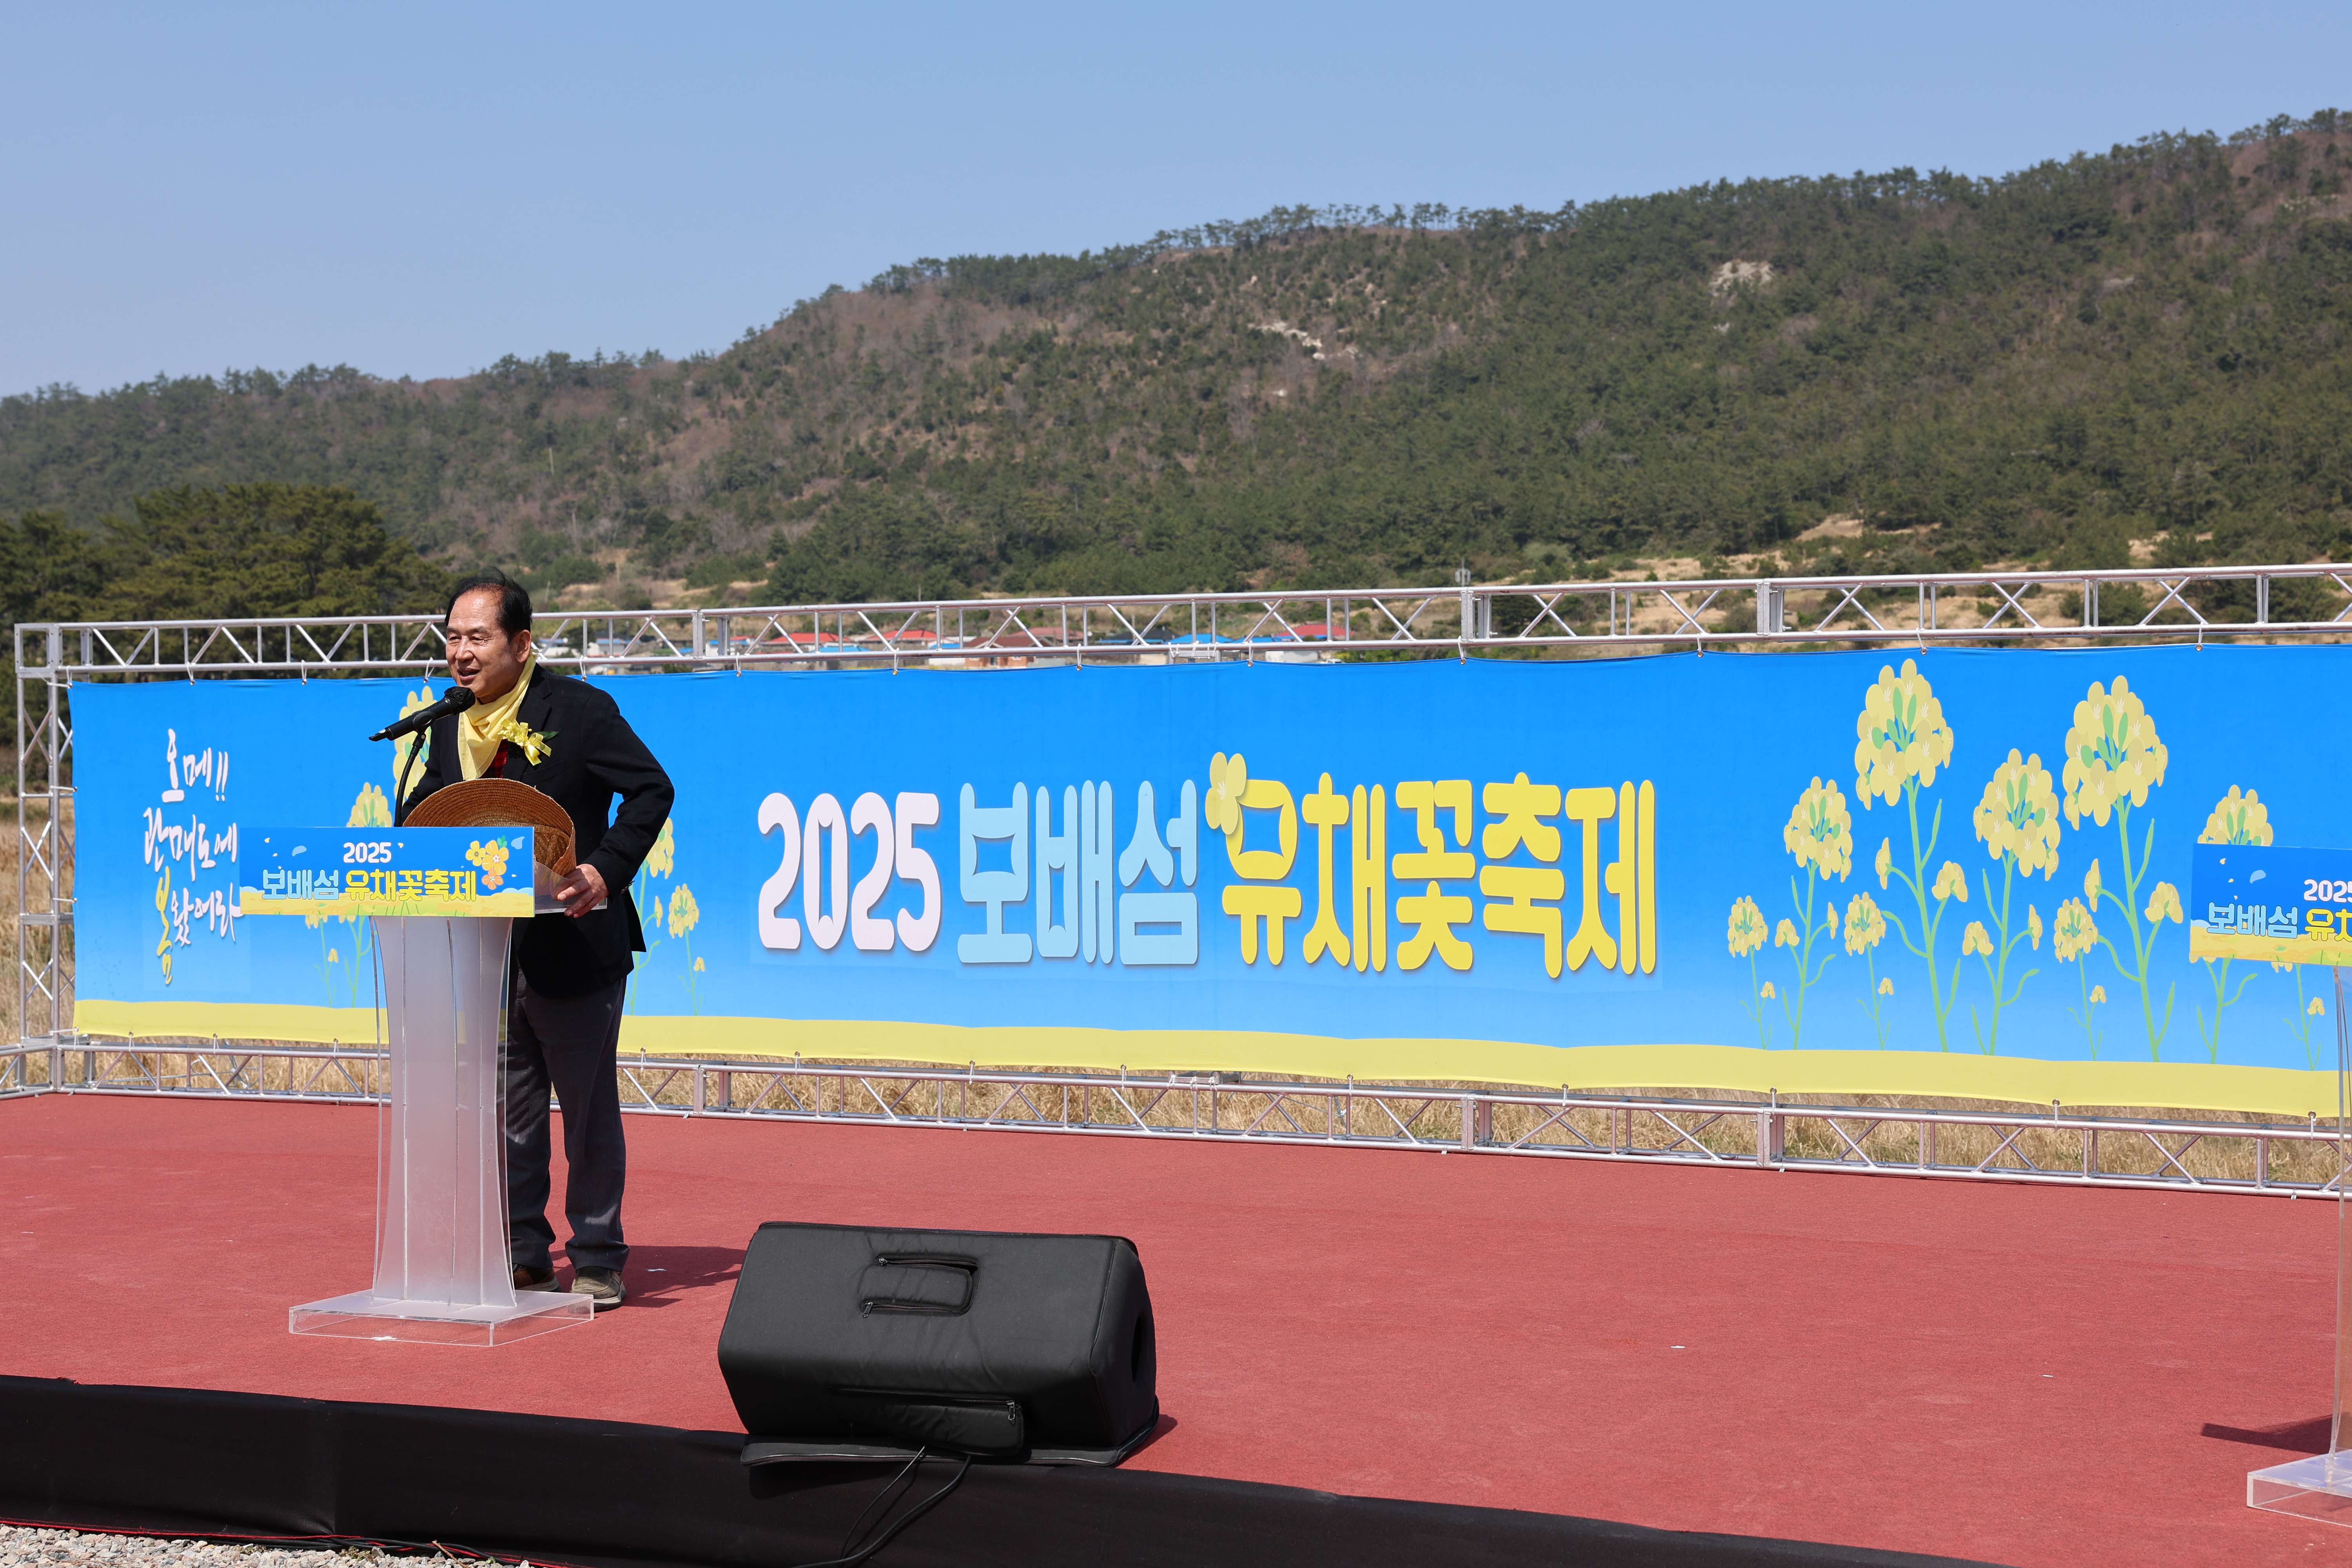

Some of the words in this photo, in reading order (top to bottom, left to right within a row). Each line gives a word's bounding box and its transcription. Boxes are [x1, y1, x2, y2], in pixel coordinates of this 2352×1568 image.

[162, 728, 229, 803] 오메!!
[343, 842, 392, 863] 2025
[262, 869, 339, 900] 보배섬
[344, 869, 477, 902] 유채꽃축제
[758, 792, 941, 951] 2025
[957, 779, 1198, 965] 보배섬
[1222, 772, 1656, 978] 유채꽃축제
[2207, 902, 2298, 939] 보배섬
